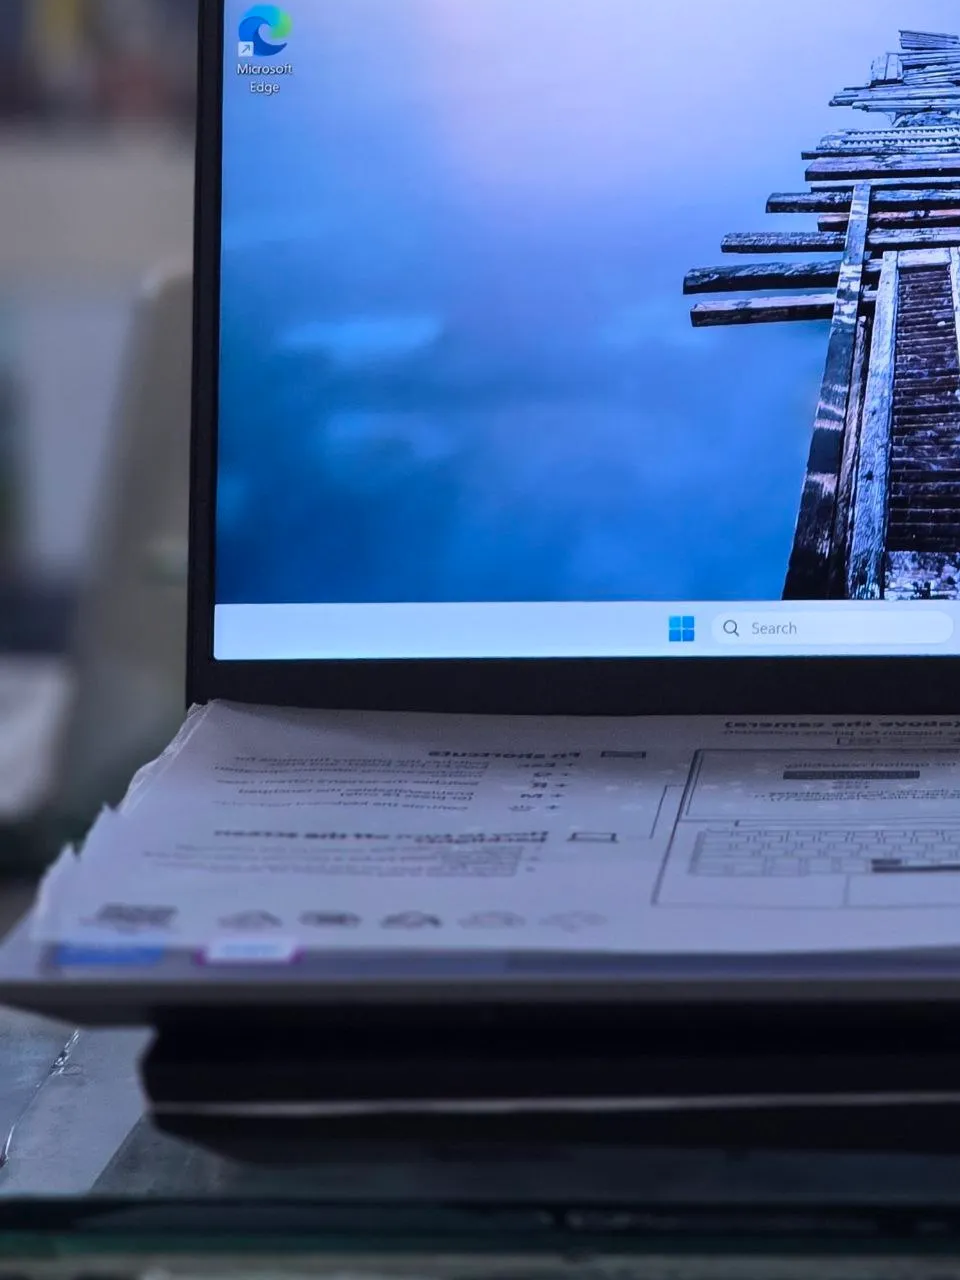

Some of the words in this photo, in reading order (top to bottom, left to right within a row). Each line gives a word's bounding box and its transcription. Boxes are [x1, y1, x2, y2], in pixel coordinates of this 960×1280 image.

[237, 63, 293, 75] Microsoft
[250, 82, 280, 95] Edge
[751, 622, 797, 635] Search
